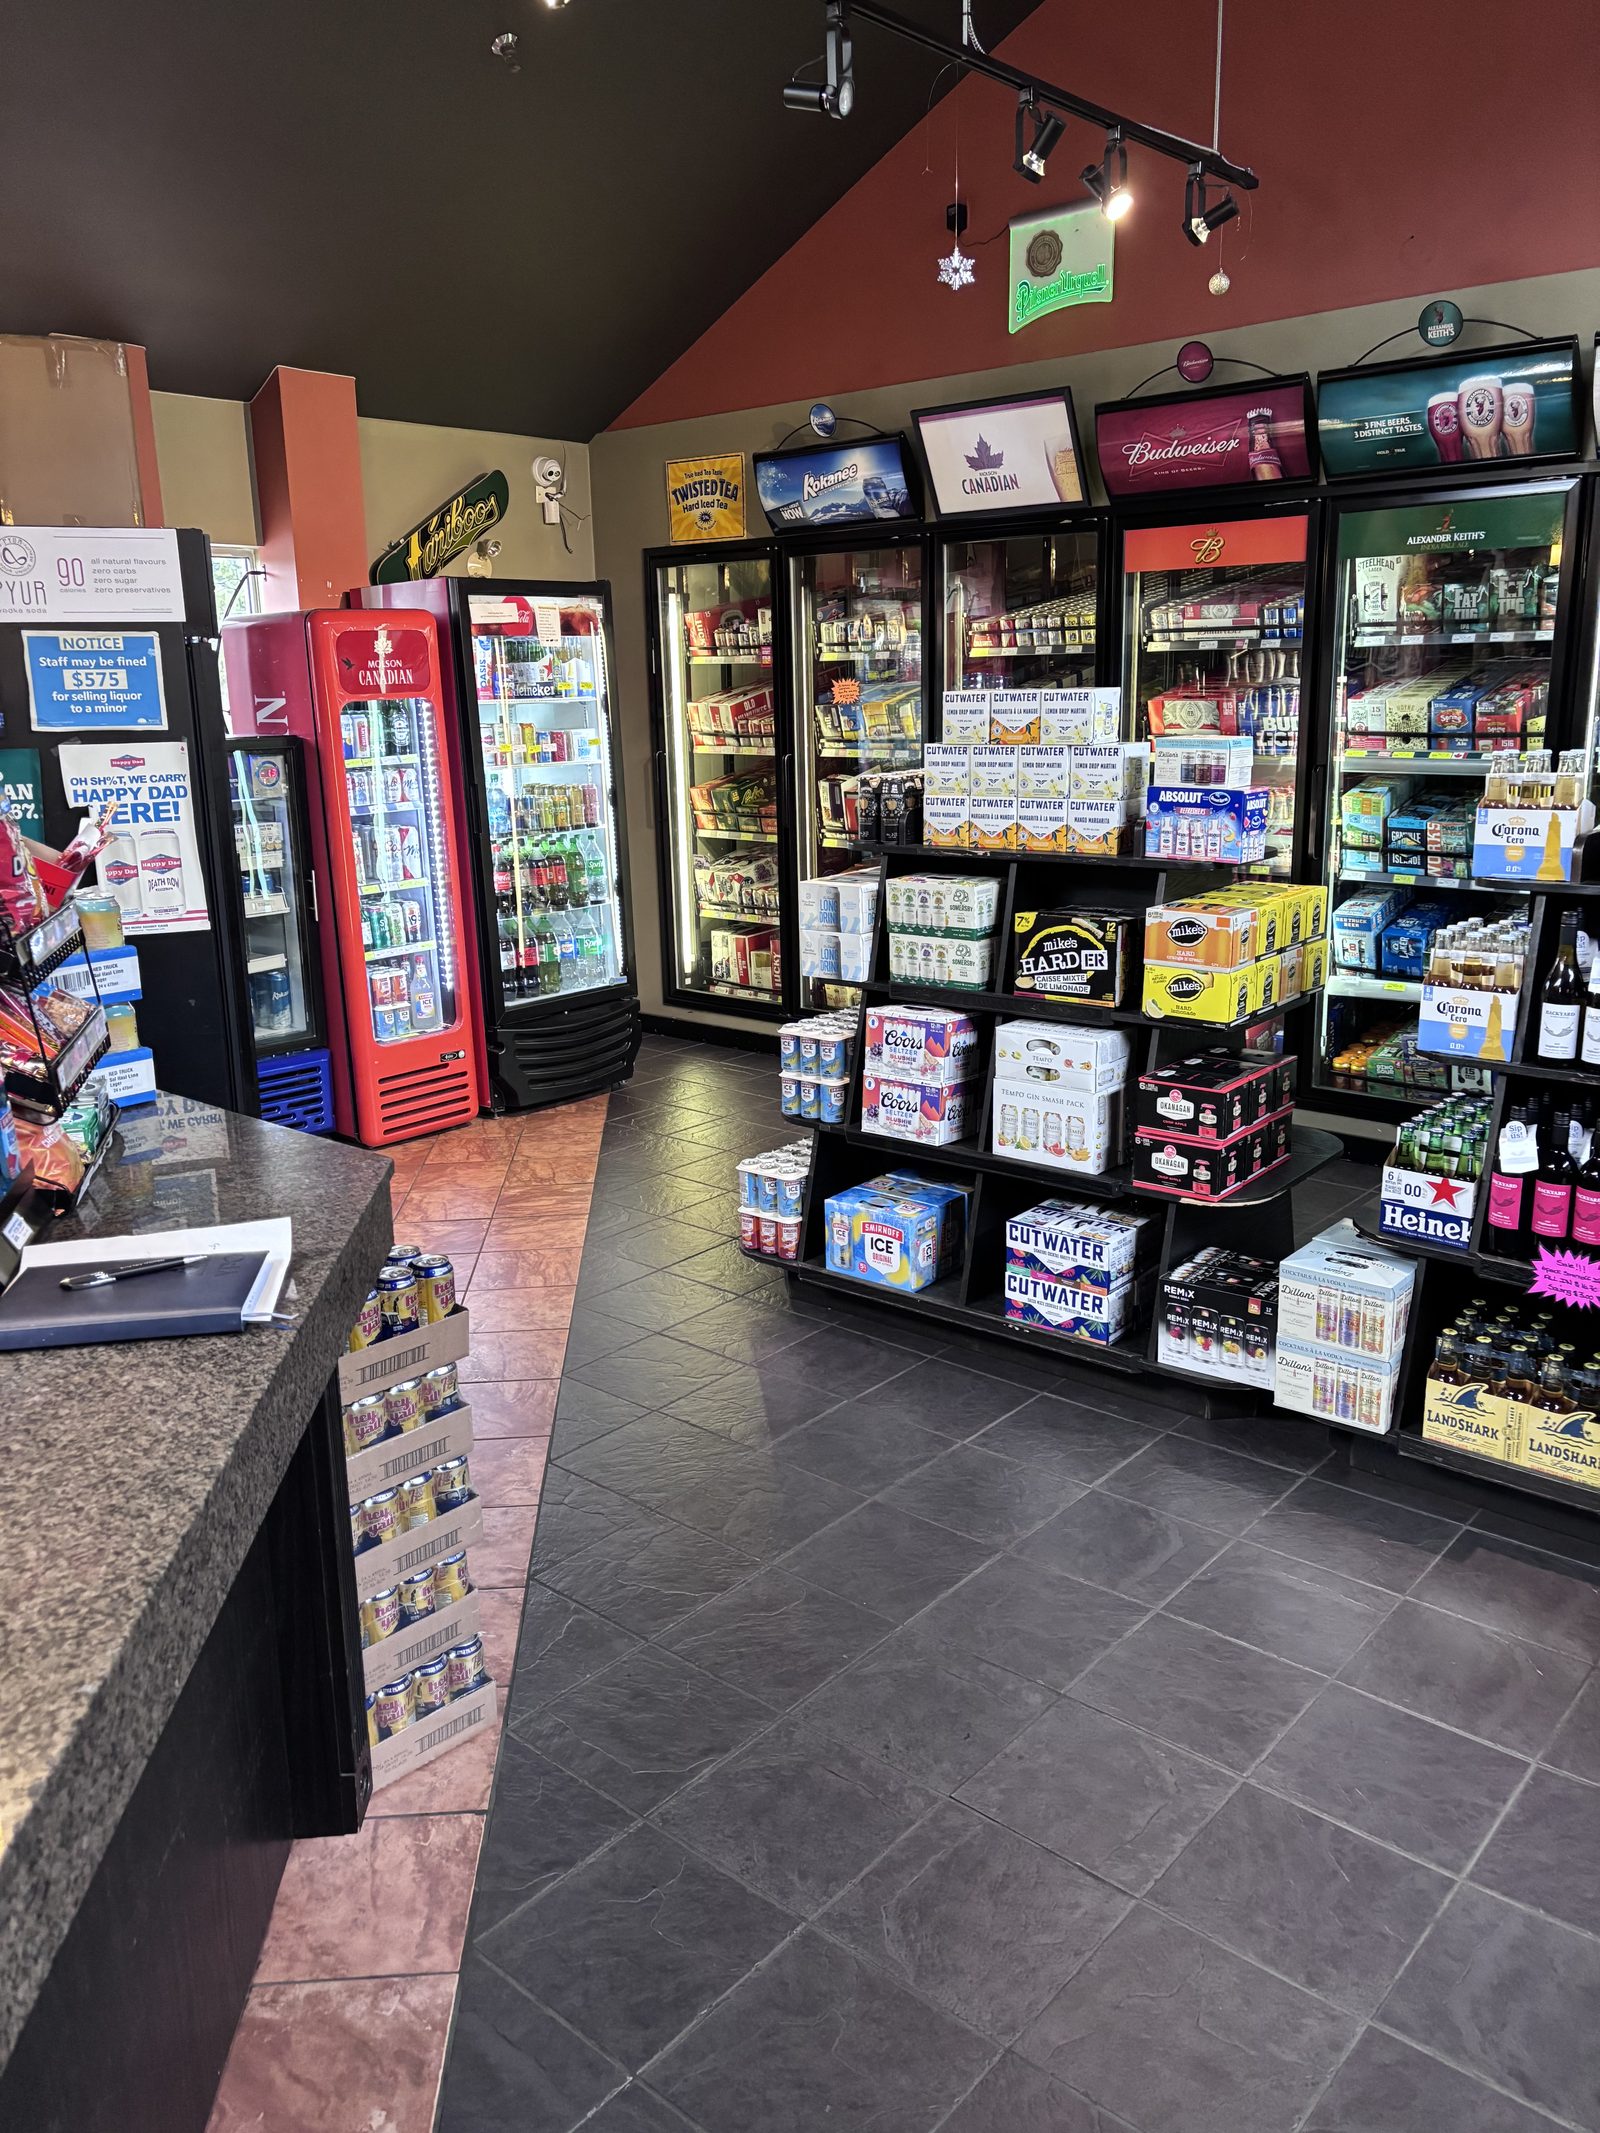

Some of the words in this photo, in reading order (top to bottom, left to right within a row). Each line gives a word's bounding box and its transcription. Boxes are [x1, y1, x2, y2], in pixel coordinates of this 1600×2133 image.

[1016, 280, 1061, 322] Pilsner
[1428, 323, 1454, 331] ALEXANDER
[1428, 328, 1455, 339] KEITH'S
[1364, 422, 1370, 430] 3
[1369, 420, 1386, 429] FINE
[1387, 417, 1412, 427] BEERS.
[1354, 431, 1359, 439] 3
[1359, 426, 1395, 438] DISTINCT
[1396, 423, 1424, 434] TASTES.
[1122, 436, 1240, 465] Budweiser
[803, 464, 858, 502] Kokanee
[961, 473, 1020, 495] CANADIAN
[672, 479, 718, 505] TWISTED
[719, 479, 739, 501] TEA
[682, 501, 699, 513] Hard
[700, 498, 715, 508] Iced
[716, 499, 728, 510] Tea
[780, 506, 804, 520] NOW
[1407, 534, 1451, 545] ALEXANDER
[1454, 531, 1486, 541] KEITH'S
[91, 558, 101, 566] all
[1357, 557, 1395, 572] STEELHEAD
[57, 557, 85, 587] 90
[114, 578, 138, 586] sugar
[115, 586, 171, 594] preservatives
[1498, 580, 1526, 599] FAT
[1454, 588, 1479, 608] FAT
[1453, 607, 1479, 620] TUG
[63, 637, 121, 650] NOTICE
[39, 656, 68, 667] Staff
[71, 657, 96, 668] may
[99, 656, 115, 667] be
[116, 656, 147, 667] fined
[367, 659, 403, 668] MOLSON
[72, 671, 120, 688] $575
[358, 670, 415, 687] CANADIAN
[52, 691, 69, 701] for
[71, 691, 108, 703] selling
[109, 690, 143, 703] liquor
[1043, 692, 1090, 702] CUTWATER
[70, 704, 82, 713] to
[94, 703, 128, 713] minor
[1501, 739, 1514, 747] 1516
[1073, 747, 1119, 757] CUTWATER
[70, 777, 88, 786] OH
[127, 774, 148, 784] WE
[149, 773, 187, 783] CARRY
[72, 786, 143, 803] HAPPY
[148, 785, 188, 800] DAD
[1158, 791, 1203, 803] ABSOLUT
[926, 797, 965, 807] CUTWATER
[1246, 799, 1267, 810] ABSOLUT
[1088, 817, 1110, 825] MARGARITA
[1492, 823, 1540, 839] Corona
[1506, 835, 1525, 844] Cero
[148, 878, 166, 892] DEATH
[819, 897, 838, 911] LONG
[949, 904, 973, 912] SOMERSBY
[1016, 915, 1031, 927] 7%
[1106, 922, 1116, 932] 12
[1171, 925, 1204, 937] mike's
[1043, 937, 1078, 952] mike's
[820, 947, 839, 960] LONG
[951, 959, 976, 967] SOMERSBY
[1036, 975, 1062, 983] CAISSE
[1063, 973, 1086, 982] MIXTE
[1038, 982, 1048, 990] DE
[1049, 983, 1090, 993] LIMONADE
[1169, 981, 1201, 992] mike's
[1436, 1000, 1483, 1017] Corona
[1450, 1013, 1468, 1023] Cero
[885, 1029, 924, 1050] Coors
[889, 1047, 918, 1056] SELTZER
[119, 1067, 133, 1075] TRUCK
[881, 1092, 919, 1113] Coors
[1001, 1089, 1025, 1098] TEMPO
[1042, 1096, 1064, 1105] SMASH
[1066, 1100, 1085, 1109] PACK
[885, 1108, 913, 1118] SELTZER
[1160, 1102, 1191, 1114] OKANAGAN
[1508, 1124, 1522, 1134] Sip
[1510, 1131, 1524, 1140] us!
[1134, 1136, 1142, 1145] 6
[1155, 1156, 1186, 1169] OKANAGAN
[1388, 1171, 1394, 1181] 6
[1404, 1183, 1421, 1197] 0.0
[1538, 1187, 1567, 1196] BACKYARD
[835, 1229, 846, 1237] ICE
[864, 1223, 903, 1240] SMIRNOFF
[870, 1237, 894, 1255] ICE
[1009, 1223, 1104, 1263] CUTWATER
[872, 1253, 893, 1265] ORIGINAL
[1281, 1268, 1312, 1280] COCKTAILS
[1326, 1278, 1347, 1288] VODKA
[434, 1277, 453, 1296] hey
[1281, 1284, 1316, 1301] Dillon's
[1007, 1275, 1104, 1315] CUTWATER
[1278, 1340, 1309, 1353] COCKTAILS
[1323, 1350, 1343, 1361] VODKA
[1278, 1356, 1312, 1373] Dillon's
[384, 1397, 411, 1414] hey
[1427, 1410, 1499, 1440] LANDSHARK
[1447, 1428, 1478, 1443] Lager
[1550, 1459, 1583, 1474] Lager
